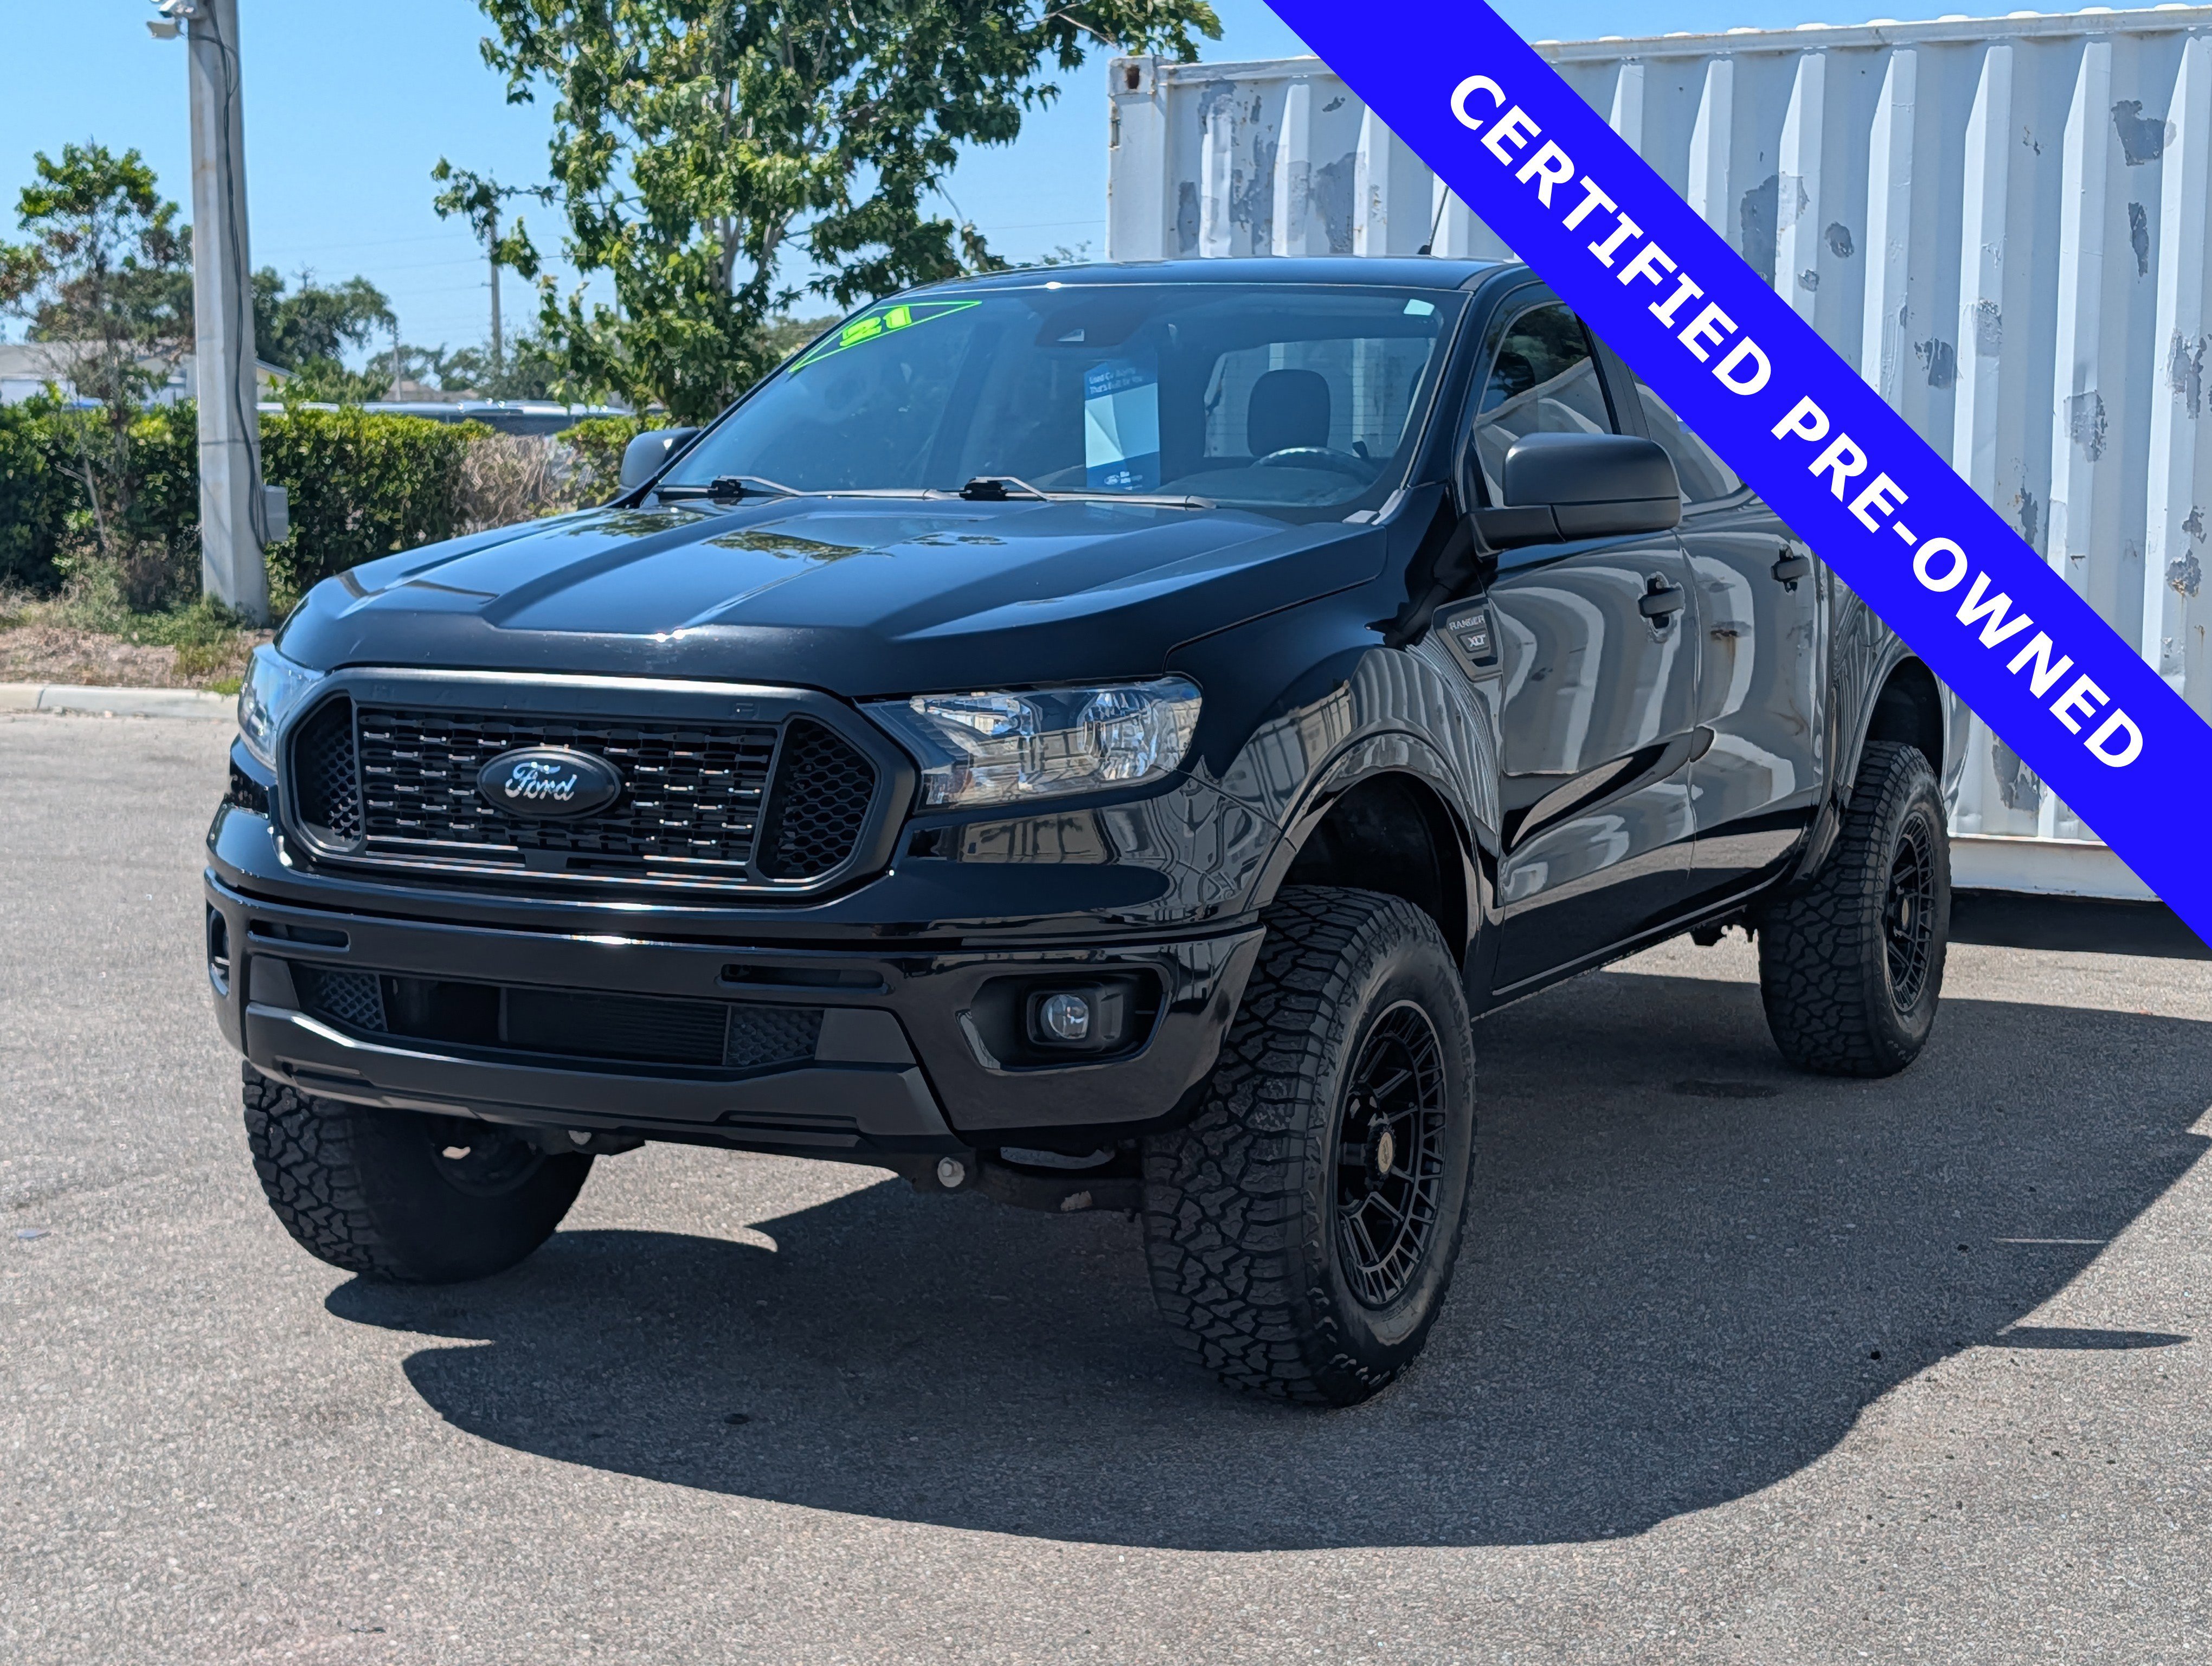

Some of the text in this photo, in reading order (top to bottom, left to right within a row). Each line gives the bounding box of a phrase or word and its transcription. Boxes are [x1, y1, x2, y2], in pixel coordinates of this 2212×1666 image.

[839, 306, 912, 347] 21
[1449, 615, 1485, 631] RANGER
[1467, 633, 1486, 648] XLT
[505, 761, 577, 802] Ford
